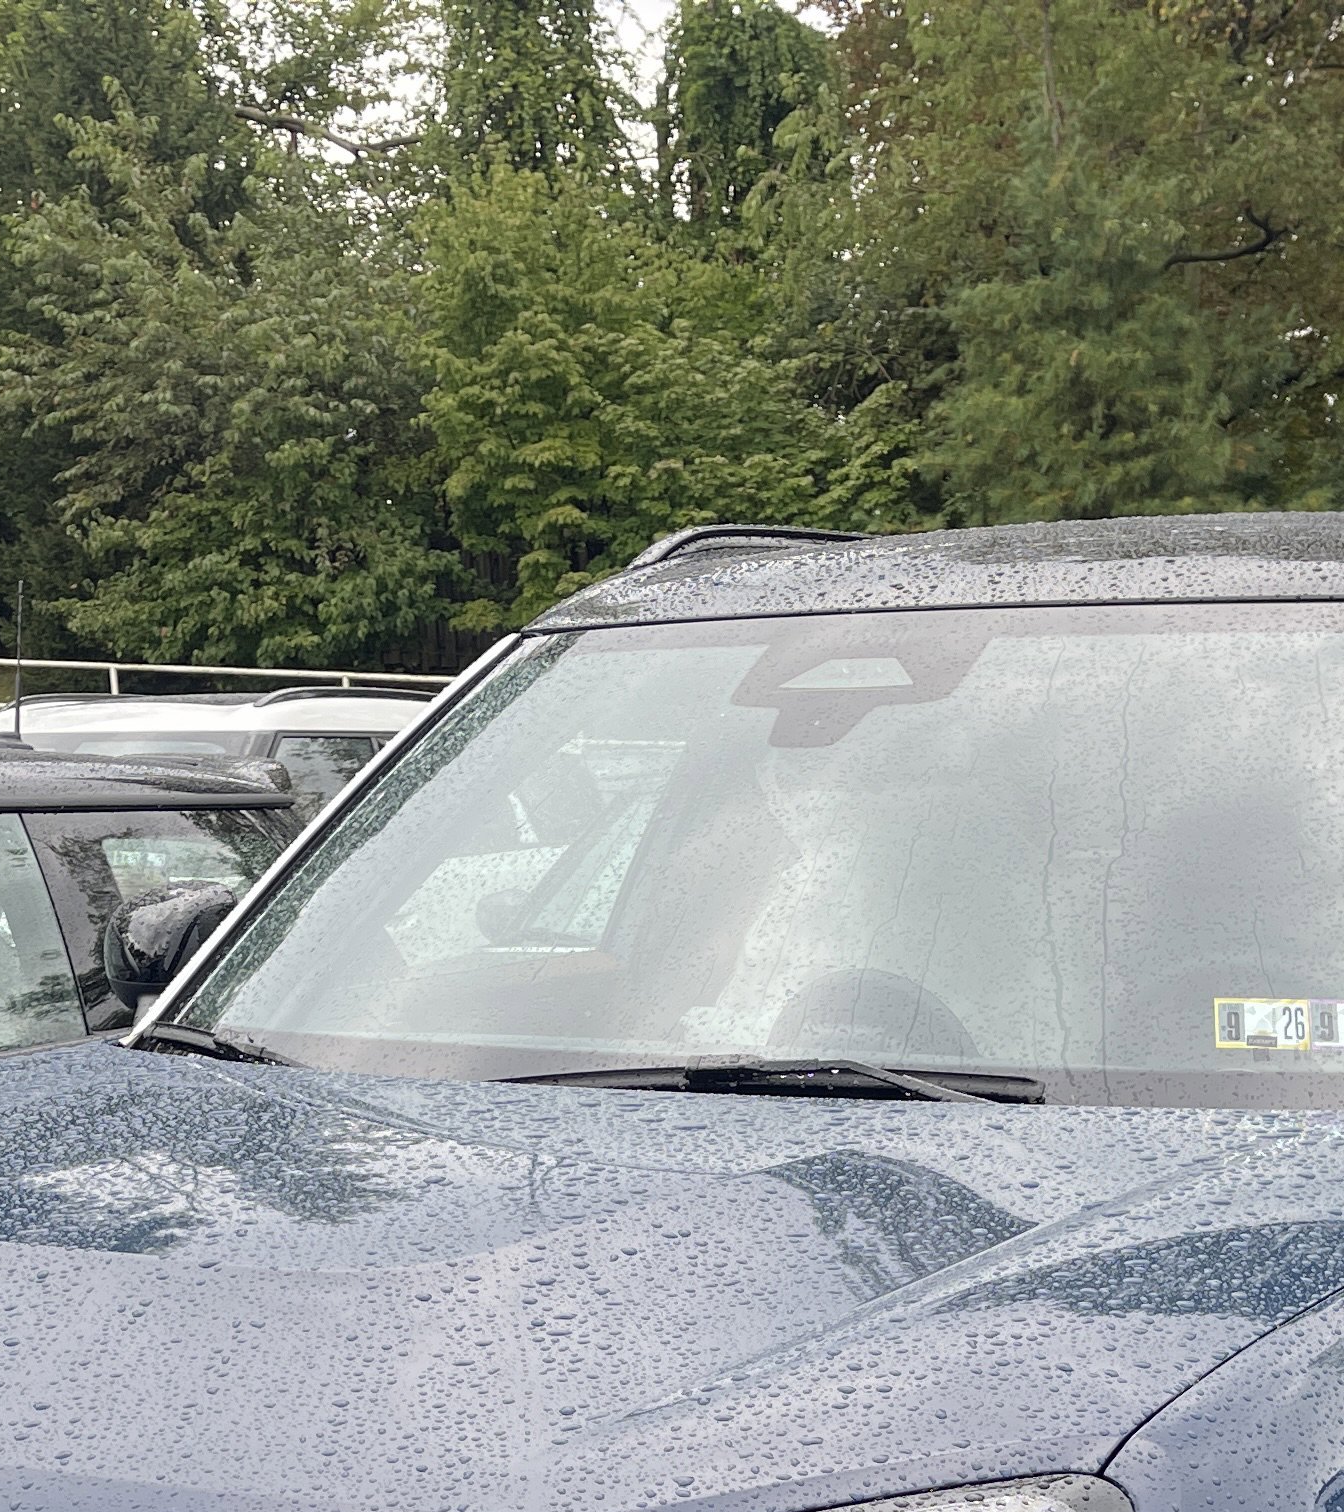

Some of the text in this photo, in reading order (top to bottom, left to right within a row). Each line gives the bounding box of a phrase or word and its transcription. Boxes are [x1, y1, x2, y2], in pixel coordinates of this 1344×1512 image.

[1227, 1006, 1305, 1041] 9 26
[1320, 1011, 1334, 1042] 9
